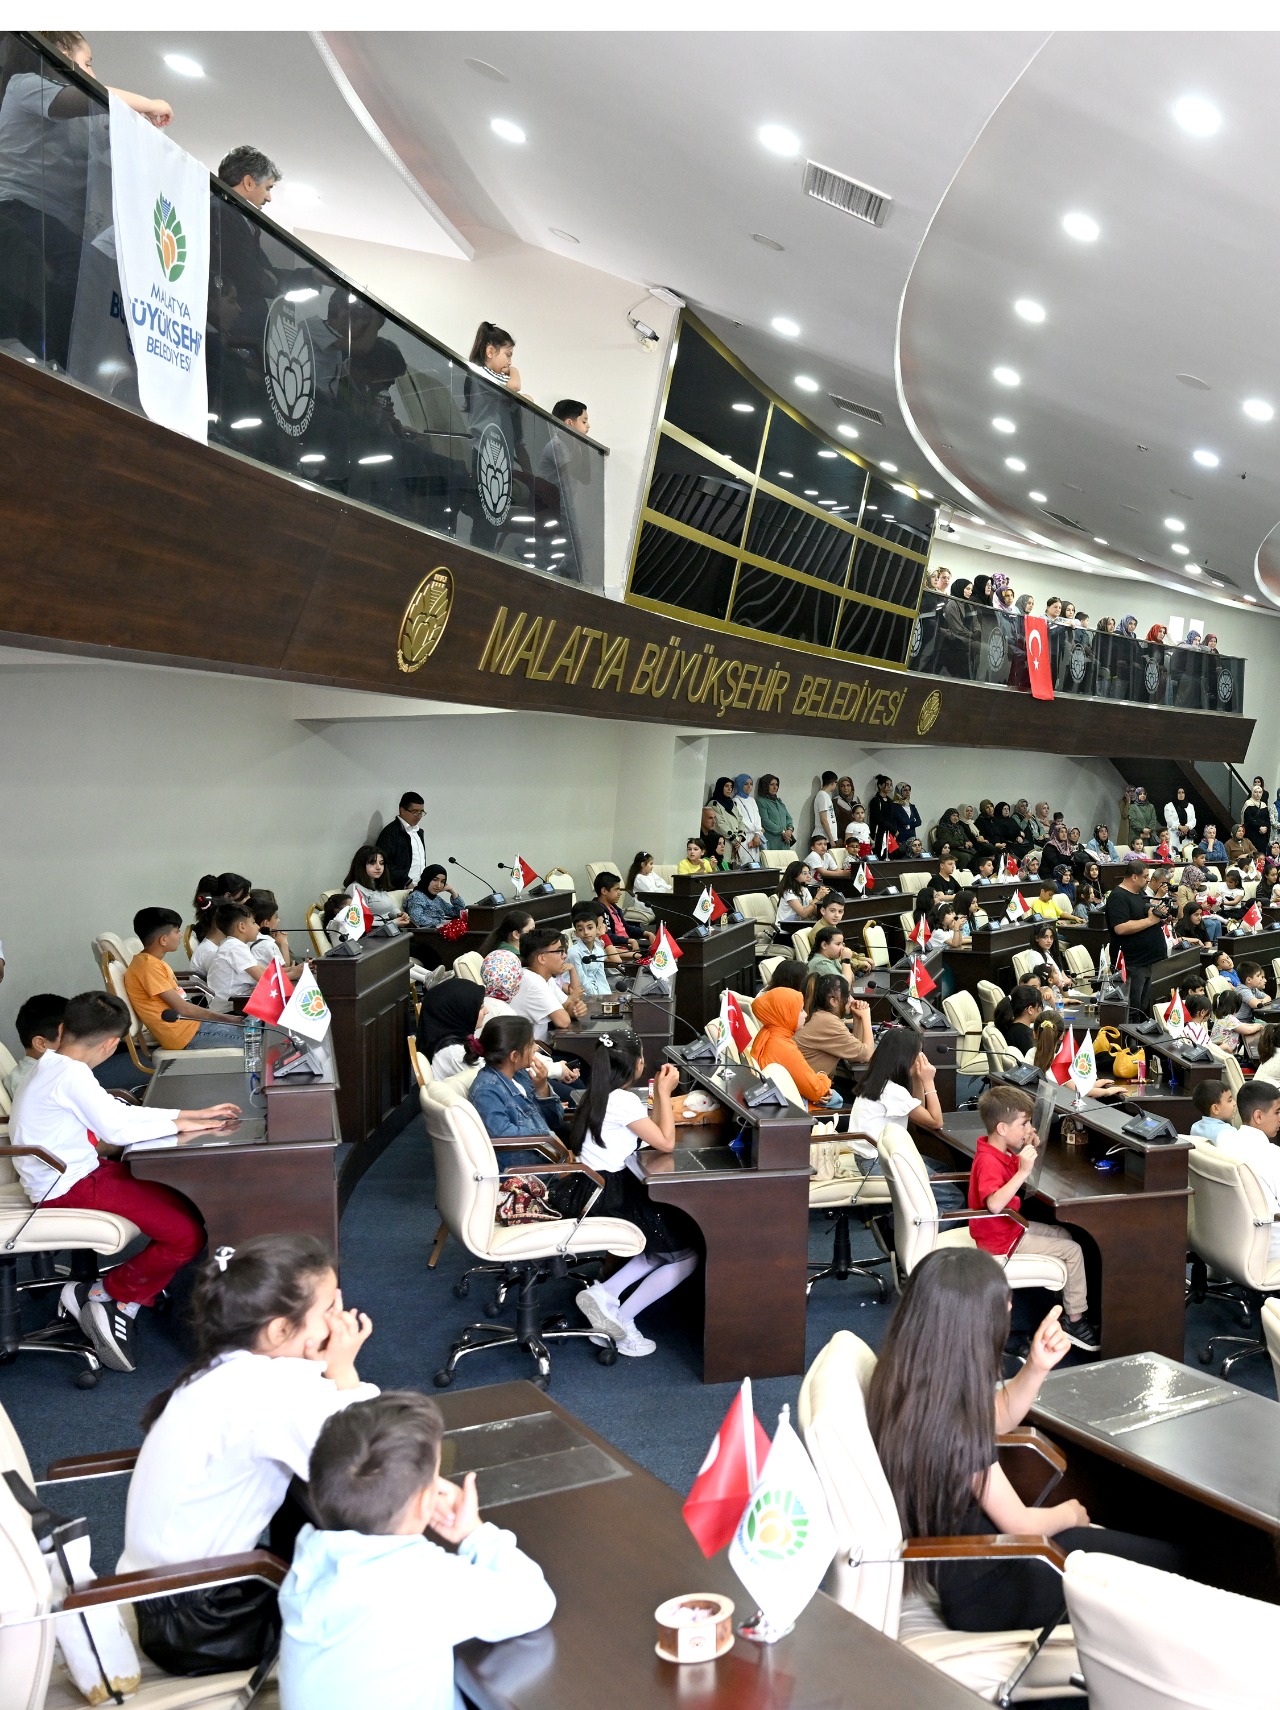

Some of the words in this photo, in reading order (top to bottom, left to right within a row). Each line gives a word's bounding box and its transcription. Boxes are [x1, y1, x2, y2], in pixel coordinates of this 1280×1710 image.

[150, 282, 191, 320] MALATYA
[477, 606, 630, 692] MALATYA
[630, 635, 791, 718] BÜYÜKŞEHİR
[791, 674, 908, 727] BELEDİYESİ
